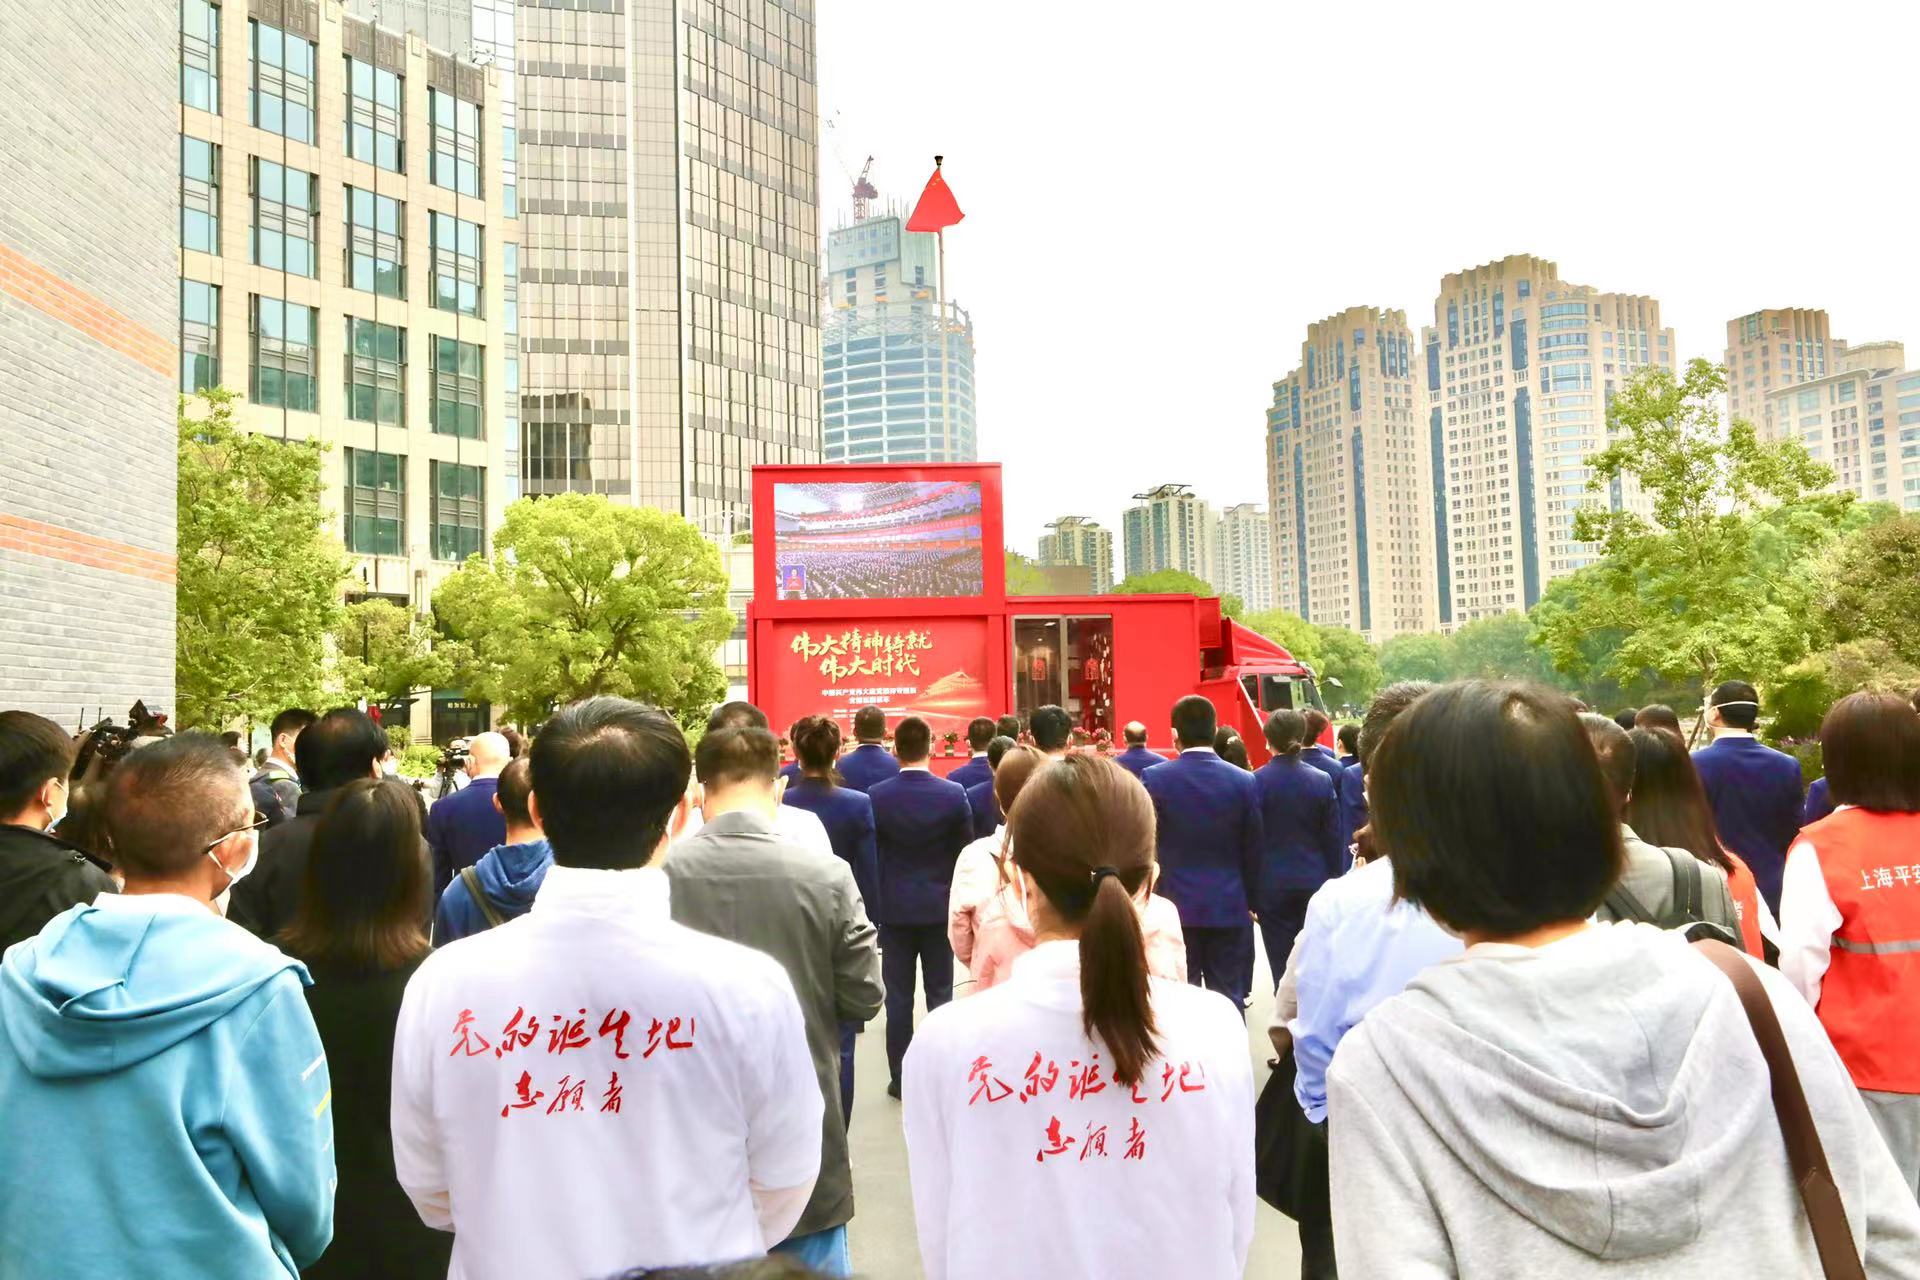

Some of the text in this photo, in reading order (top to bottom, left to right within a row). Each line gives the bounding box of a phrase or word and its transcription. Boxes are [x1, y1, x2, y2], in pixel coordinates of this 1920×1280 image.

[790, 628, 933, 663] 伟大精神铸就
[820, 653, 920, 684] 伟大时代
